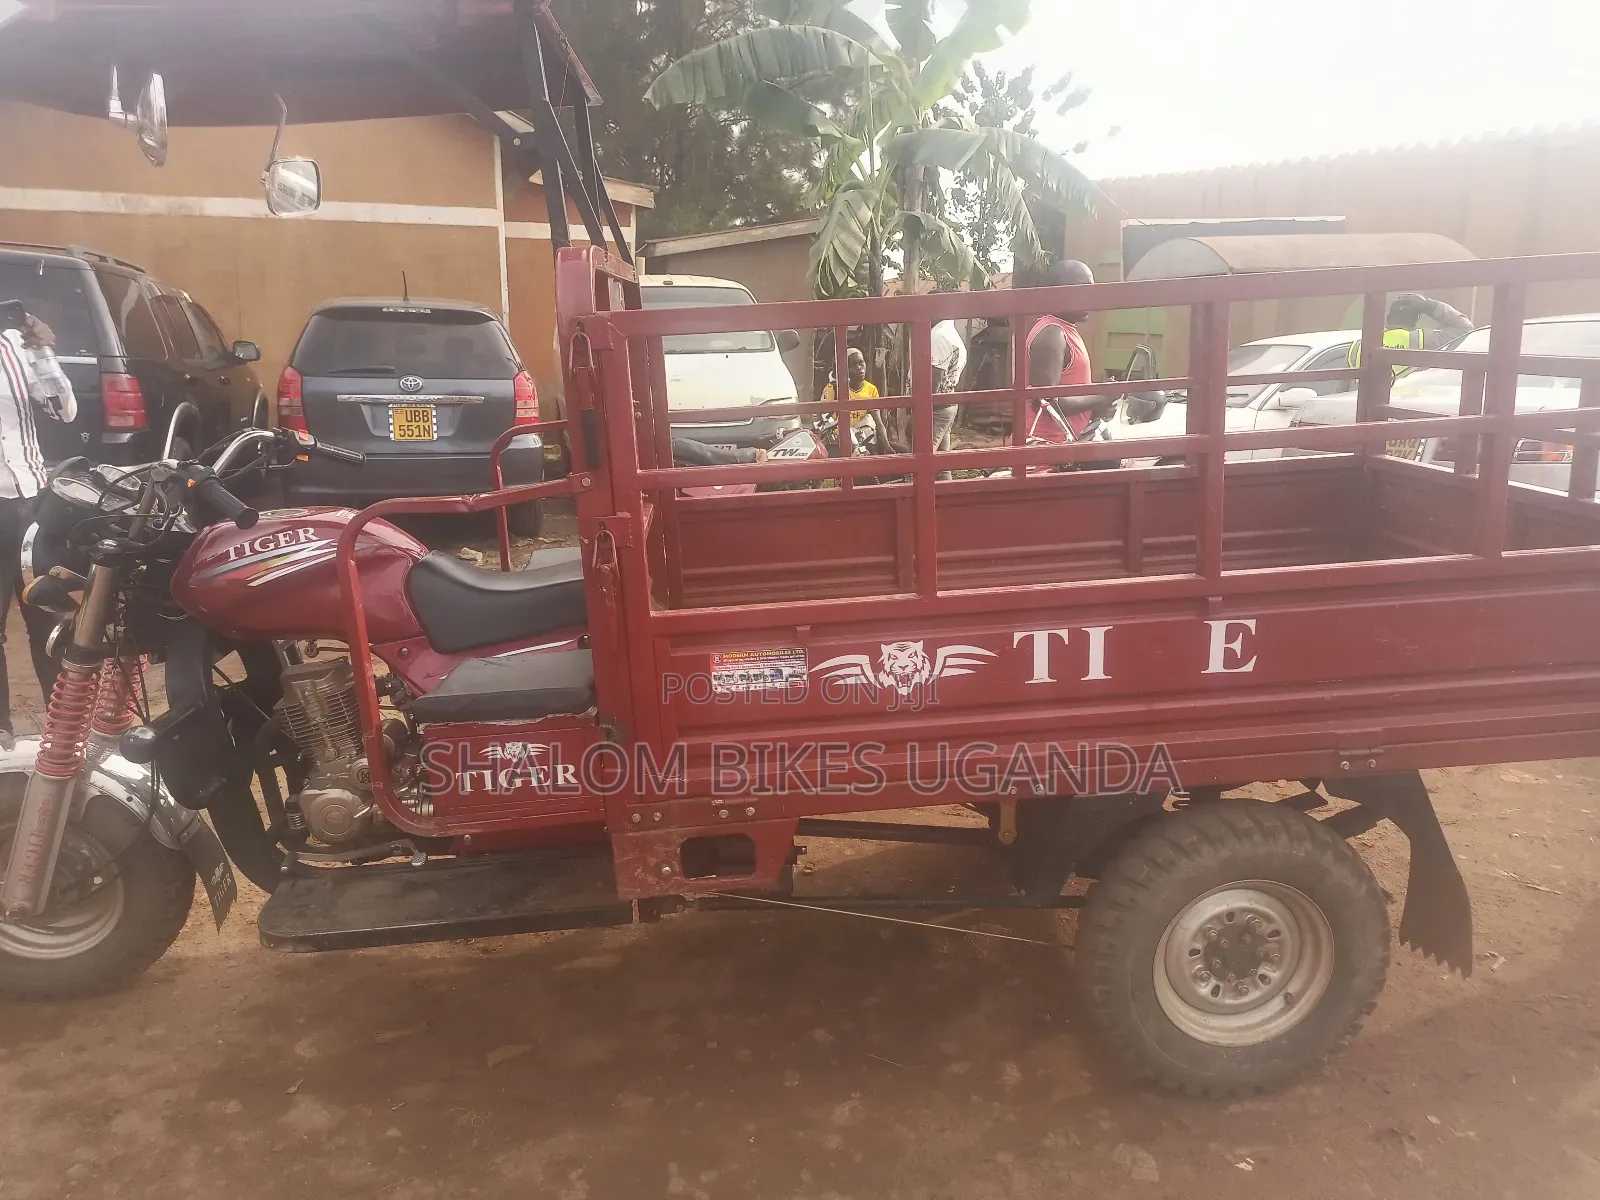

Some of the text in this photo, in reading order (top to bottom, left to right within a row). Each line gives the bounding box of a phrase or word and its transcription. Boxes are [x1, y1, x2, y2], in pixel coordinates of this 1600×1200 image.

[398, 424, 431, 438] 551N
[405, 409, 430, 423] UBB
[223, 527, 320, 561] TIGER
[455, 764, 579, 793] TIGER
[17, 829, 45, 886] TIGER
[214, 873, 232, 907] TIGER
